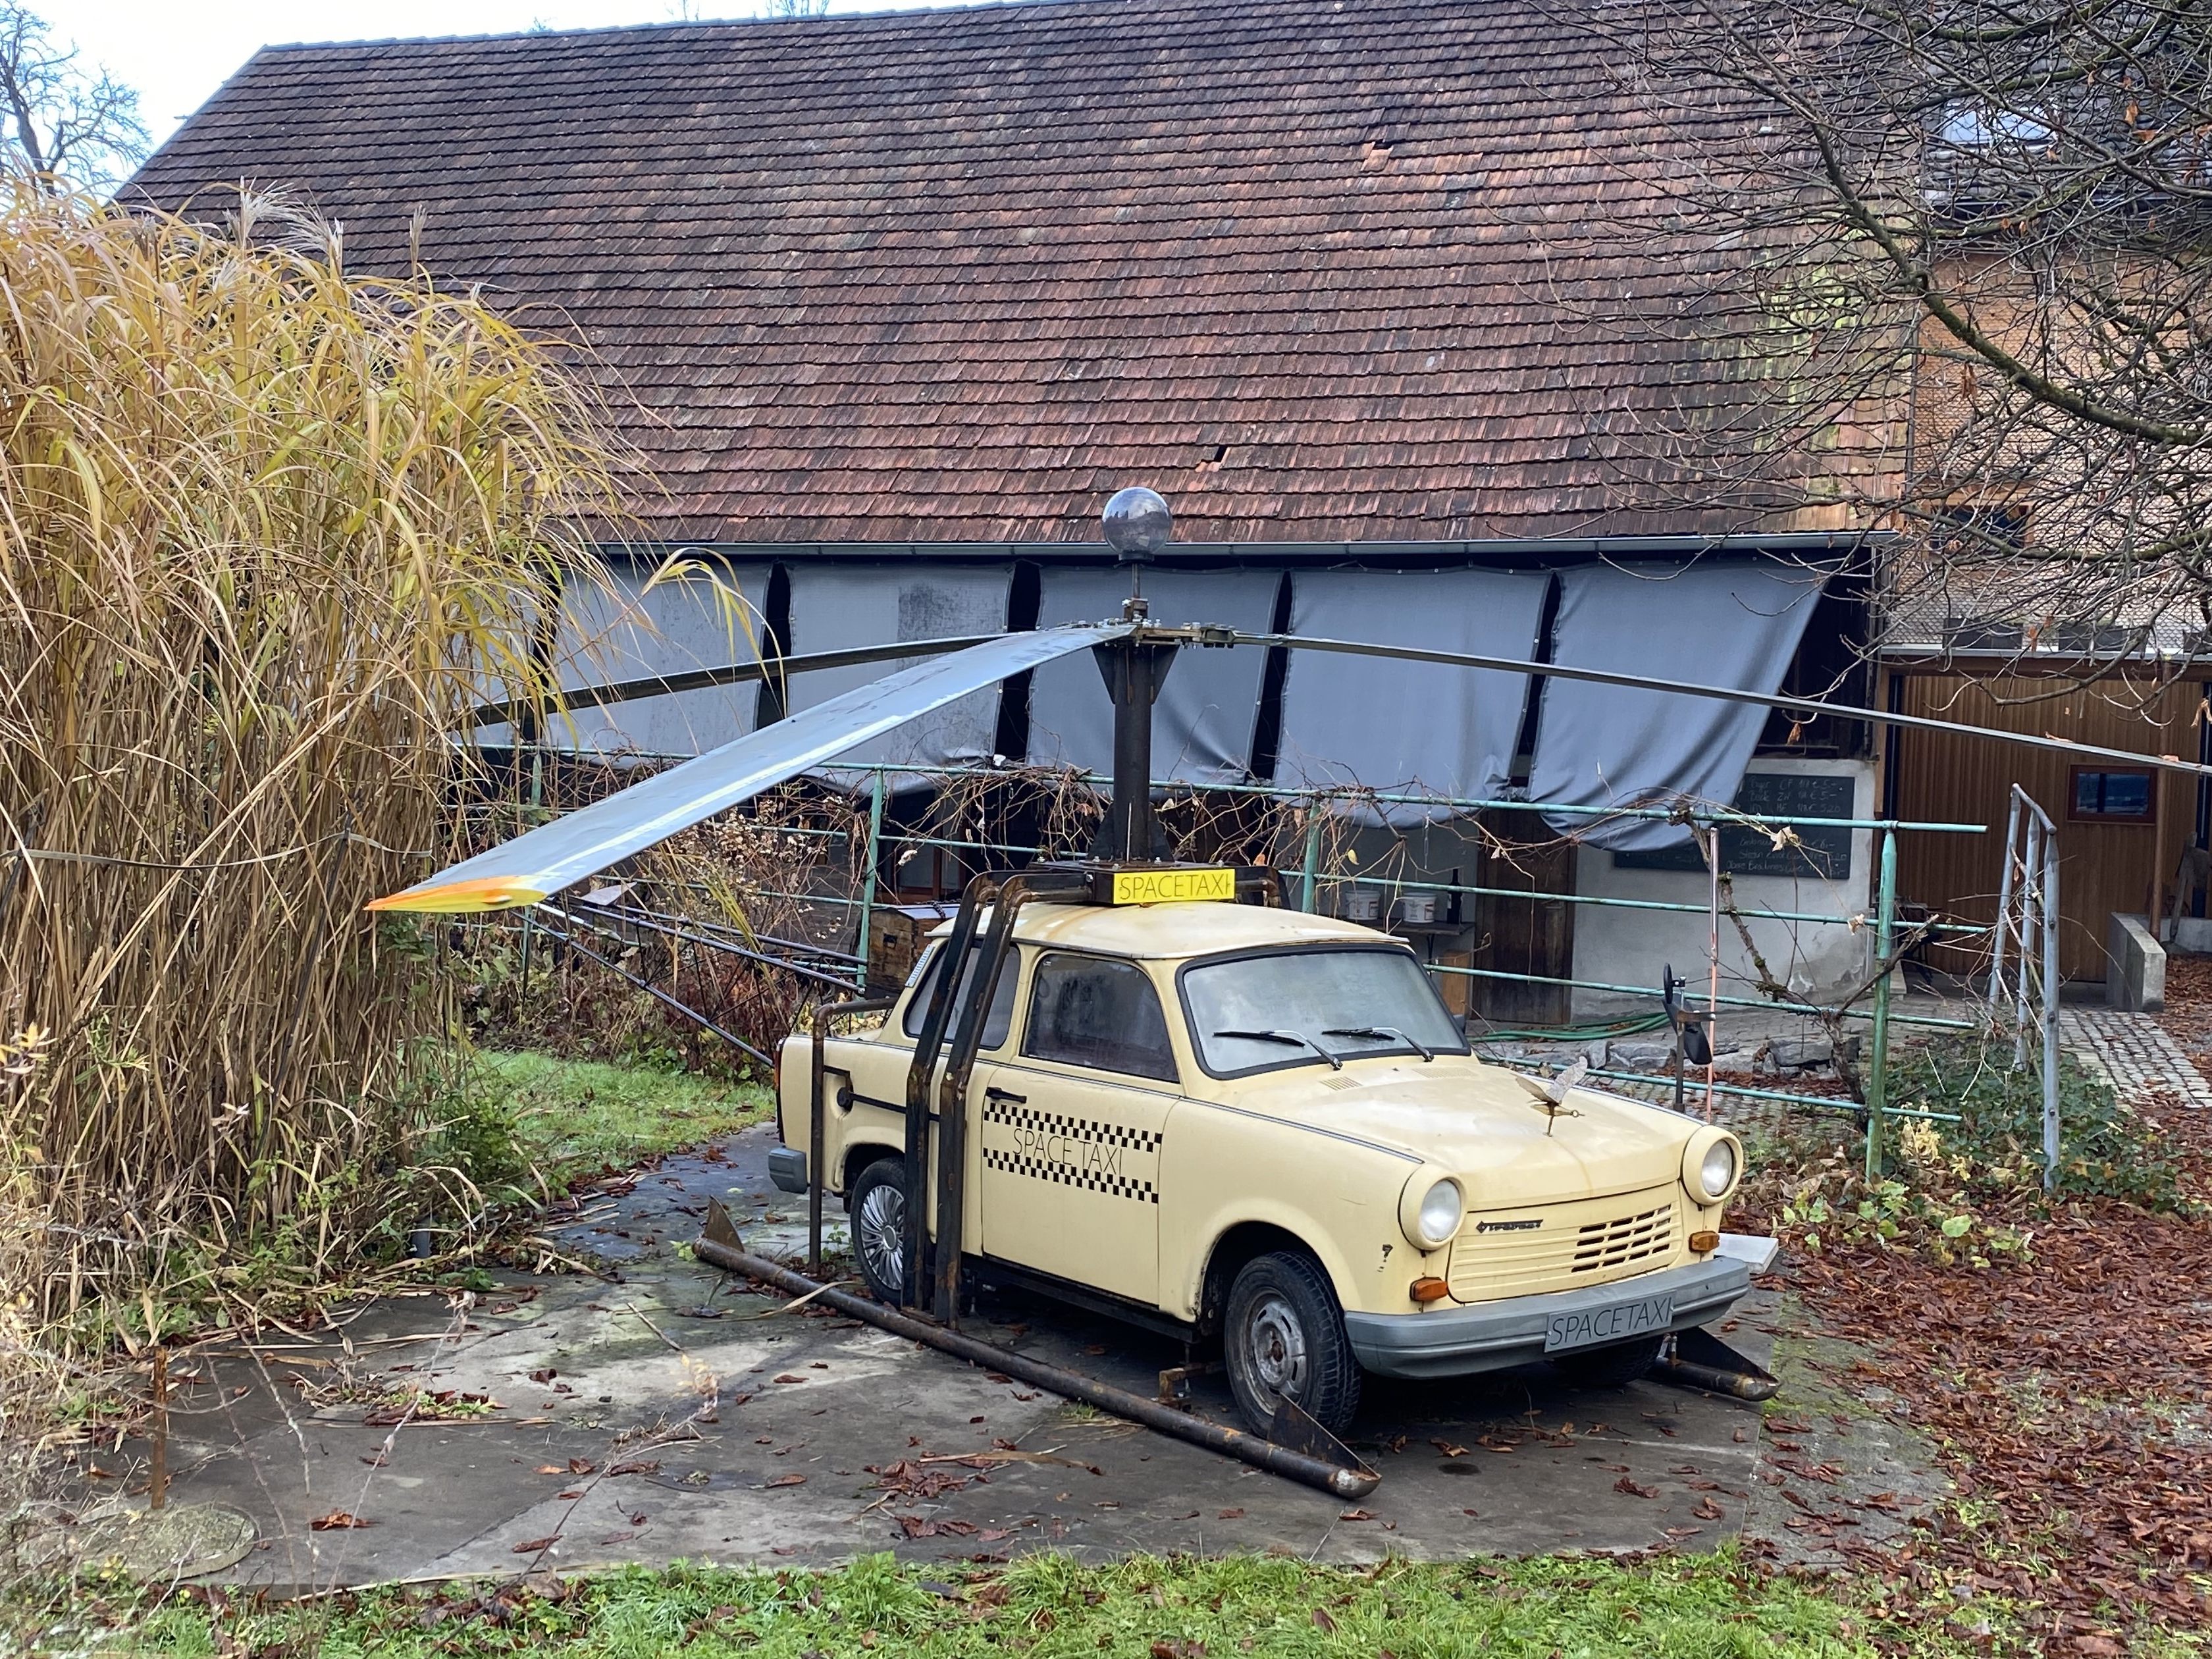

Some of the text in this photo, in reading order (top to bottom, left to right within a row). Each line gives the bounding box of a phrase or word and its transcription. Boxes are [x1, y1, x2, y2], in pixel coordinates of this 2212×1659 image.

[1120, 873, 1230, 900] SPACETAXI
[1013, 1128, 1122, 1175] SPACE TAXI
[1550, 1297, 1671, 1346] SPACETAXI
